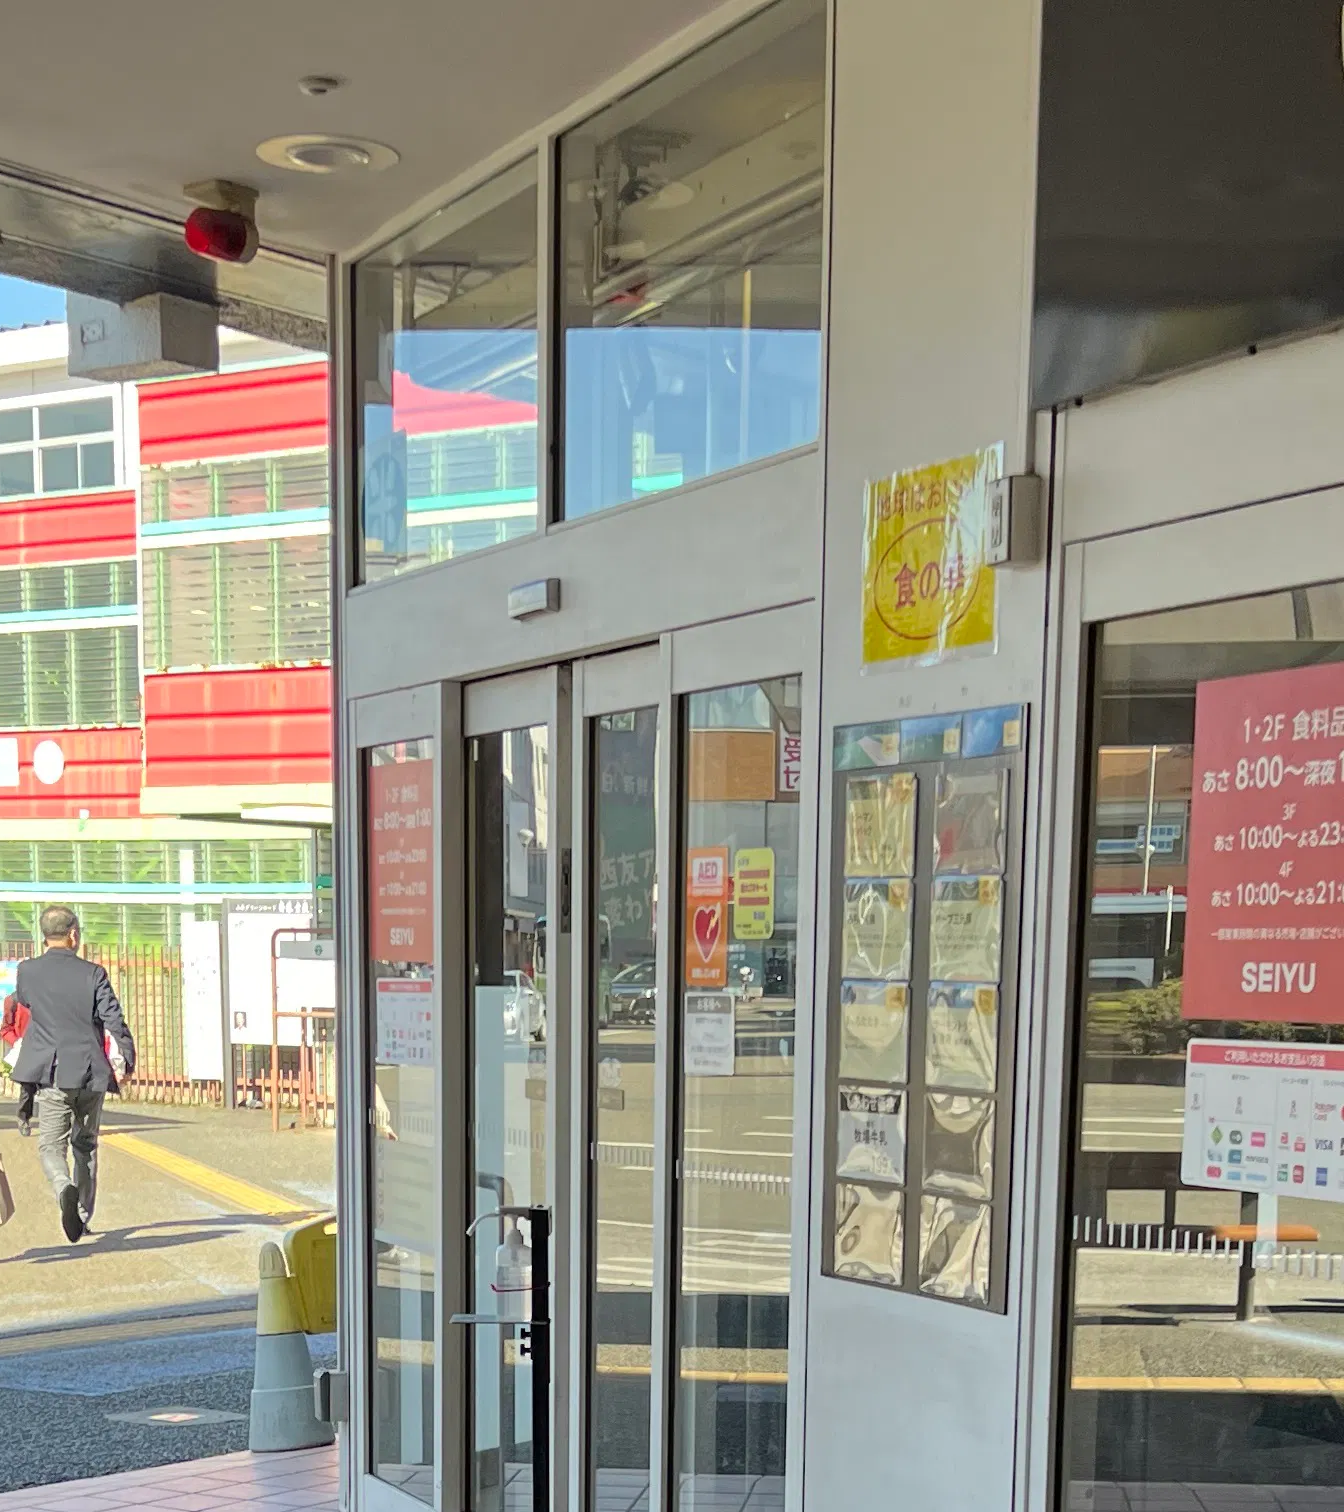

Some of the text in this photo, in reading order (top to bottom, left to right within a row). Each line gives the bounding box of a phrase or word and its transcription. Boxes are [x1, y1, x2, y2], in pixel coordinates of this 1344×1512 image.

[1202, 769, 1231, 793] あさ
[1282, 803, 1297, 821] 3F
[1214, 834, 1234, 851] あさ
[698, 861, 718, 880] AED
[1278, 860, 1294, 878] 4F
[1211, 890, 1232, 907] あさ
[390, 927, 415, 946] SEIYU
[1241, 962, 1316, 993] SEIYU
[1315, 1139, 1334, 1150] VISA
